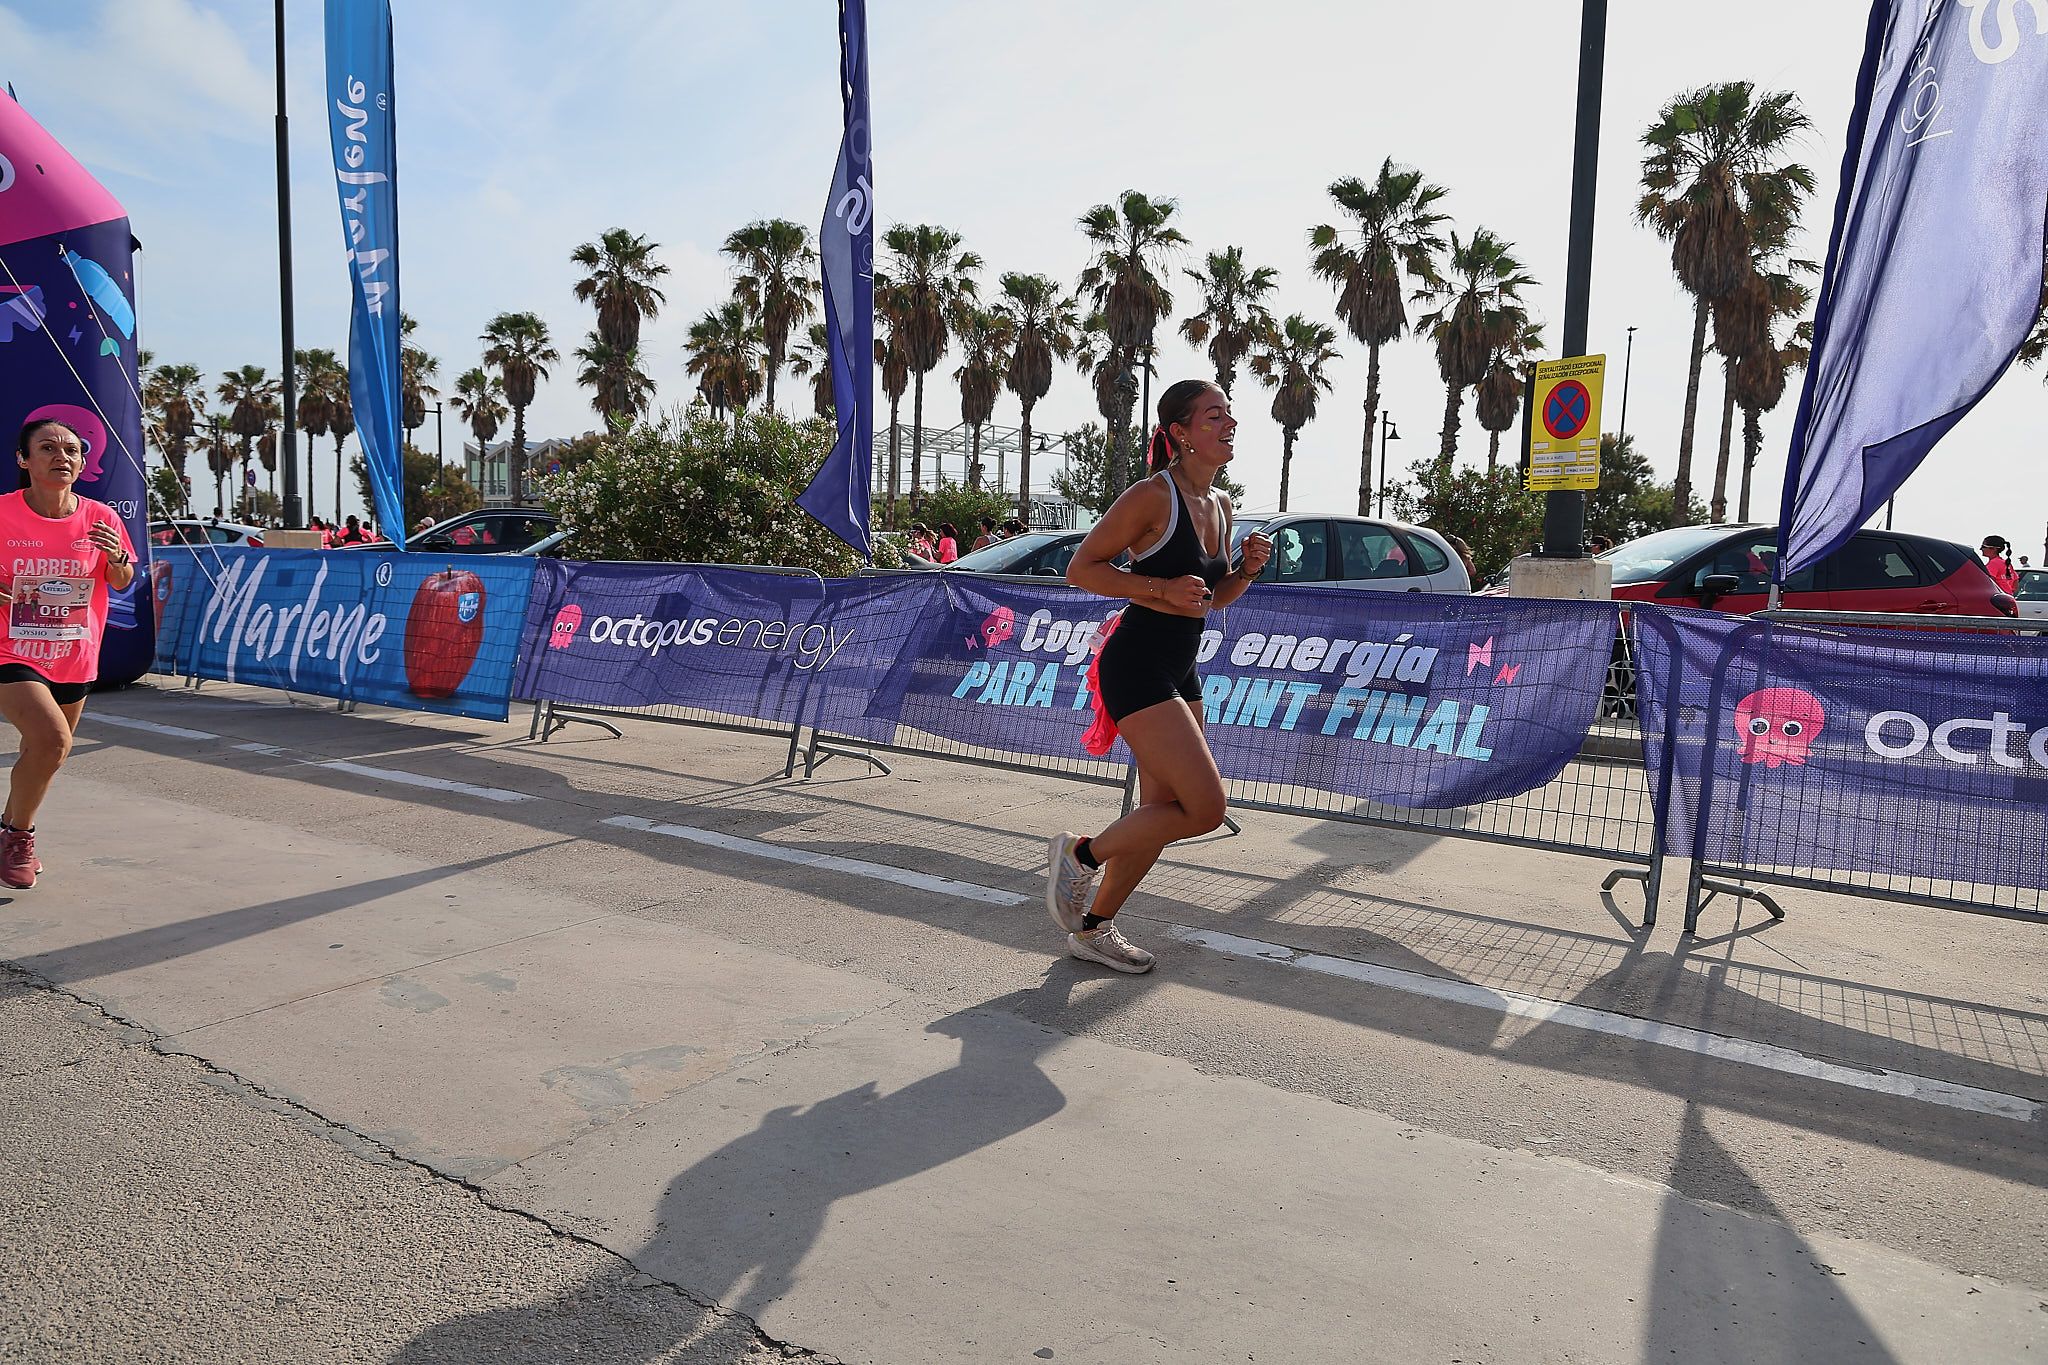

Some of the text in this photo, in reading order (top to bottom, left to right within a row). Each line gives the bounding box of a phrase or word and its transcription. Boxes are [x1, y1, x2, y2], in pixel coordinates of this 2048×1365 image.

[1523, 467, 1531, 490] VLC
[7, 539, 44, 548] OYSHO
[199, 554, 387, 685] Marlene
[589, 613, 855, 672] octopus energy
[1231, 629, 1440, 689] energía
[952, 661, 1060, 708] PARA
[1321, 685, 1494, 762] FINAL
